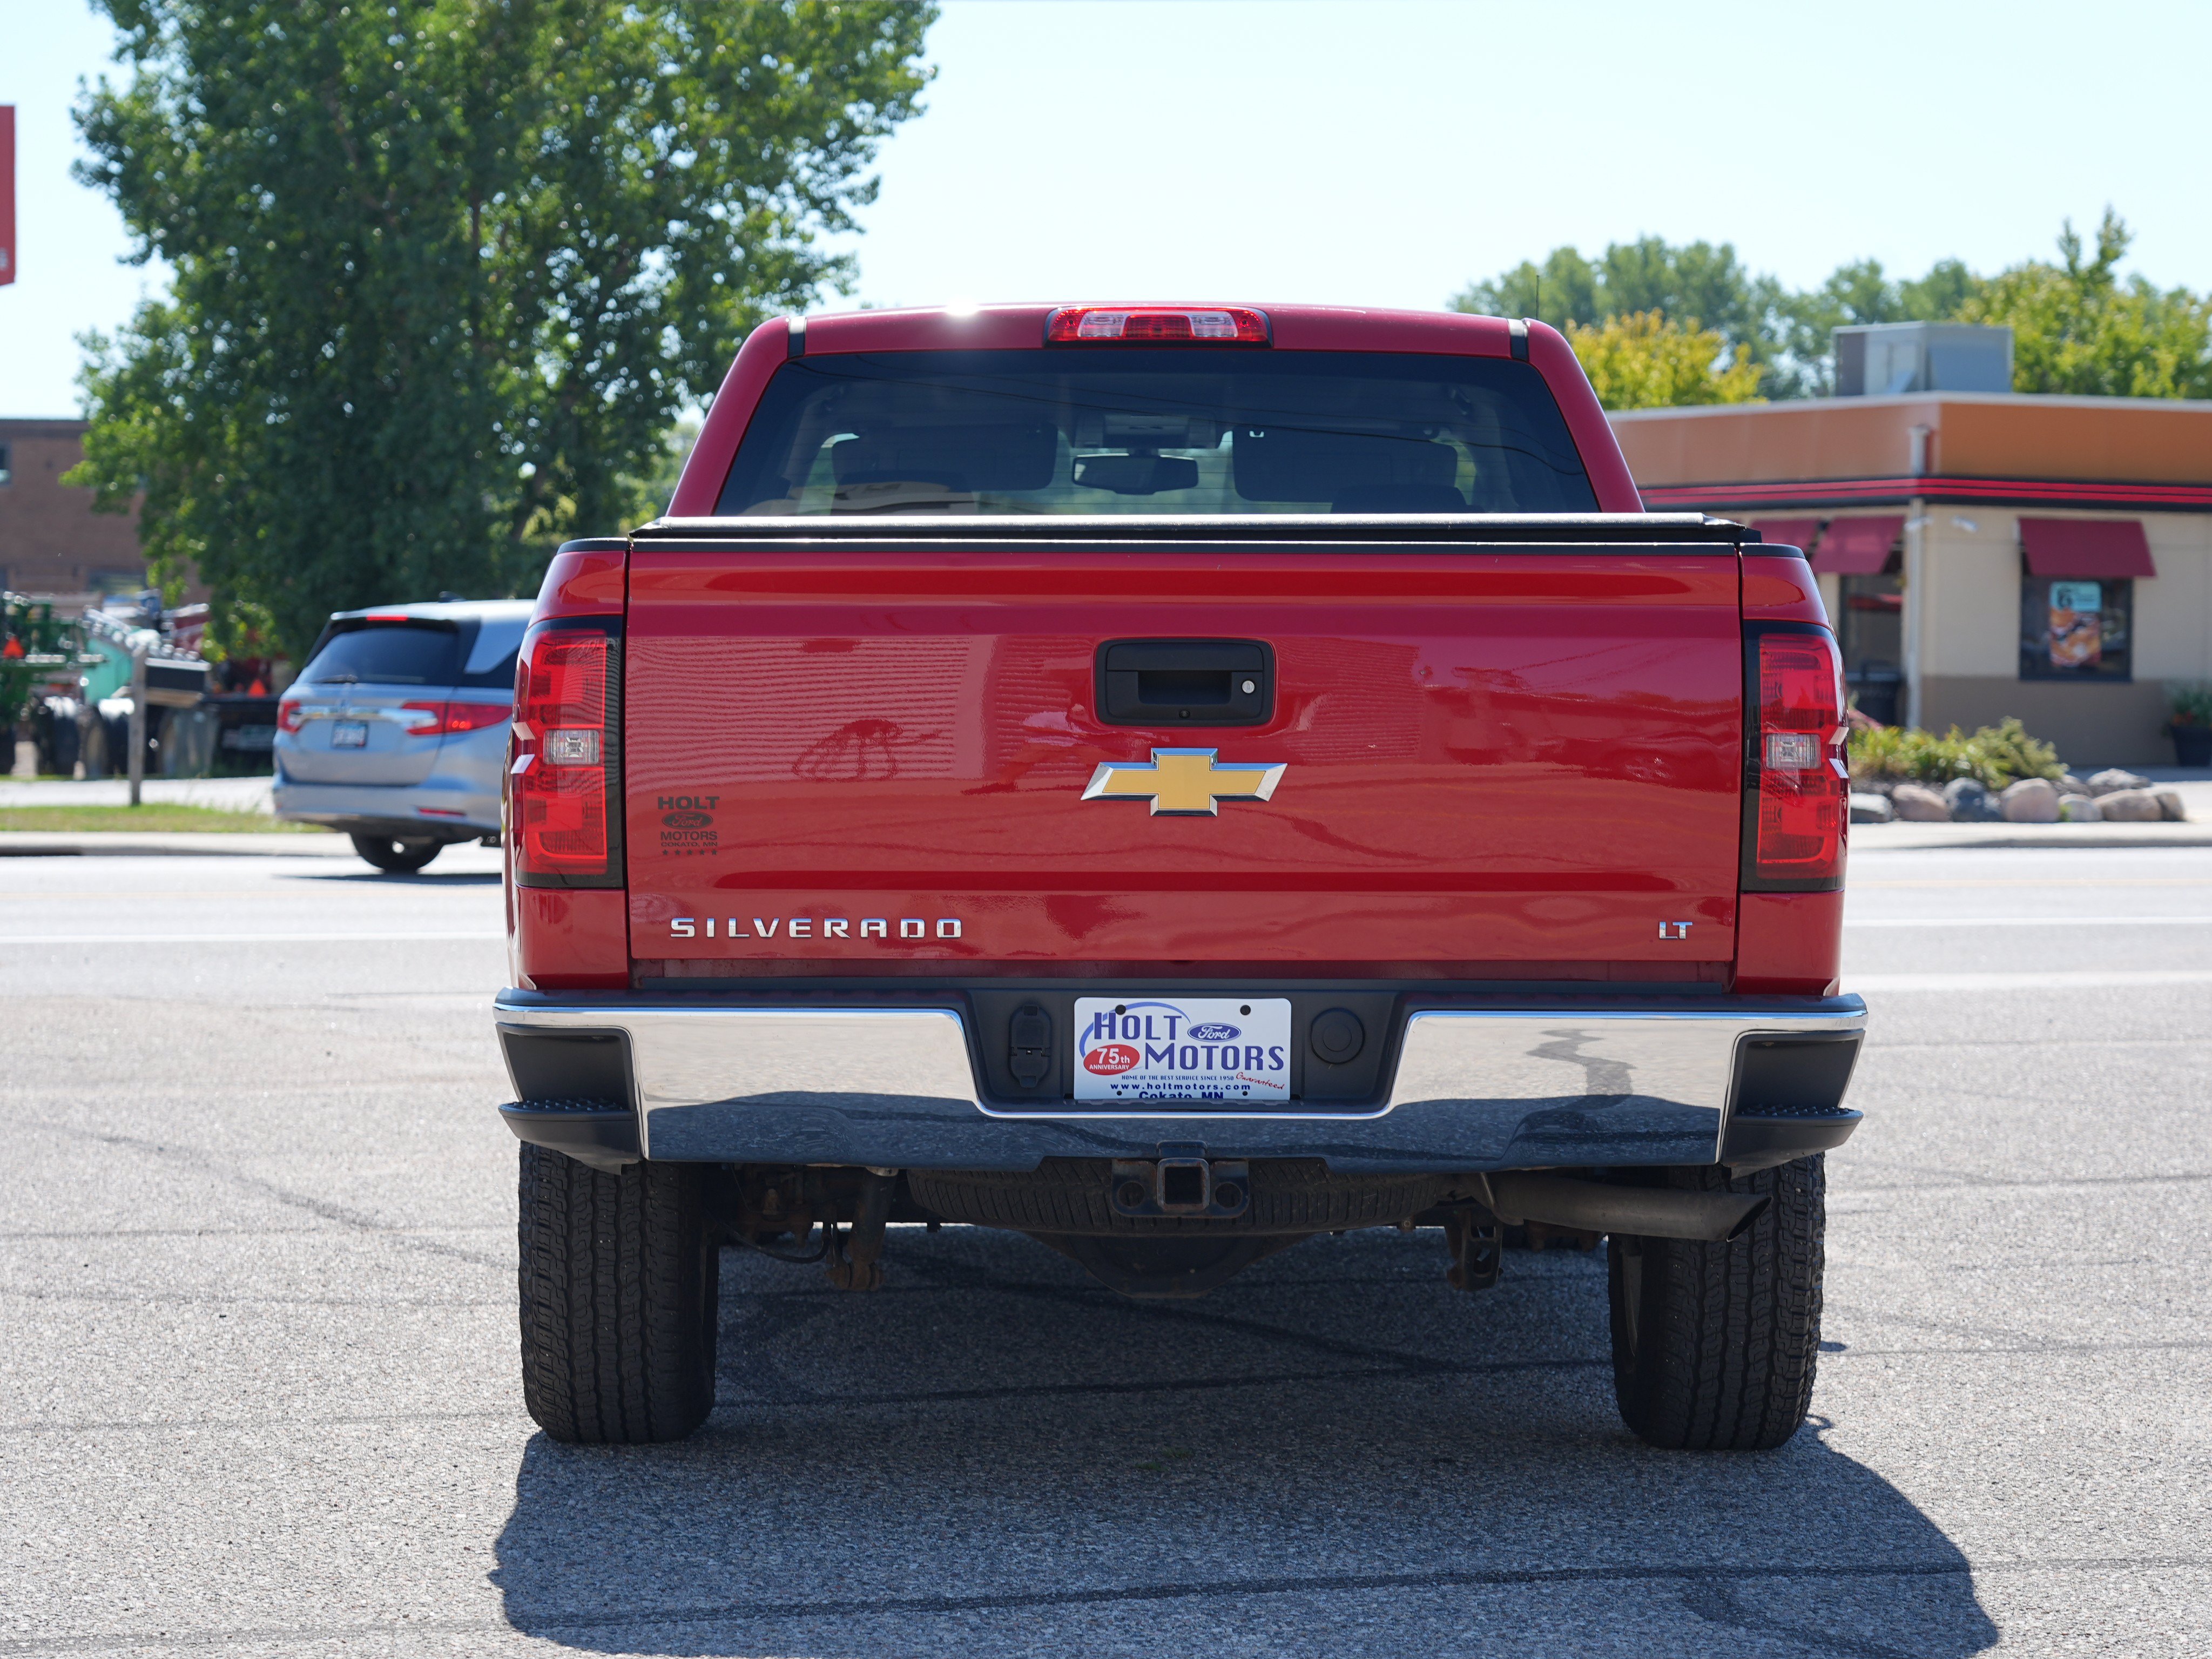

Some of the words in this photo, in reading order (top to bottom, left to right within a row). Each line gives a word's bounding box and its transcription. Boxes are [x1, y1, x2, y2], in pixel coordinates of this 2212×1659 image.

[658, 796, 720, 810] HOLT
[672, 813, 703, 826] Ford
[660, 831, 718, 840] MOTORS
[670, 918, 962, 939] SILVERADO
[1658, 921, 1693, 940] LT
[1094, 1012, 1182, 1040] HOLT
[1198, 1025, 1231, 1040] Ford
[1097, 1048, 1130, 1064] 75th
[1145, 1042, 1284, 1070] MOTORS
[1236, 1071, 1285, 1090] Guaranteed
